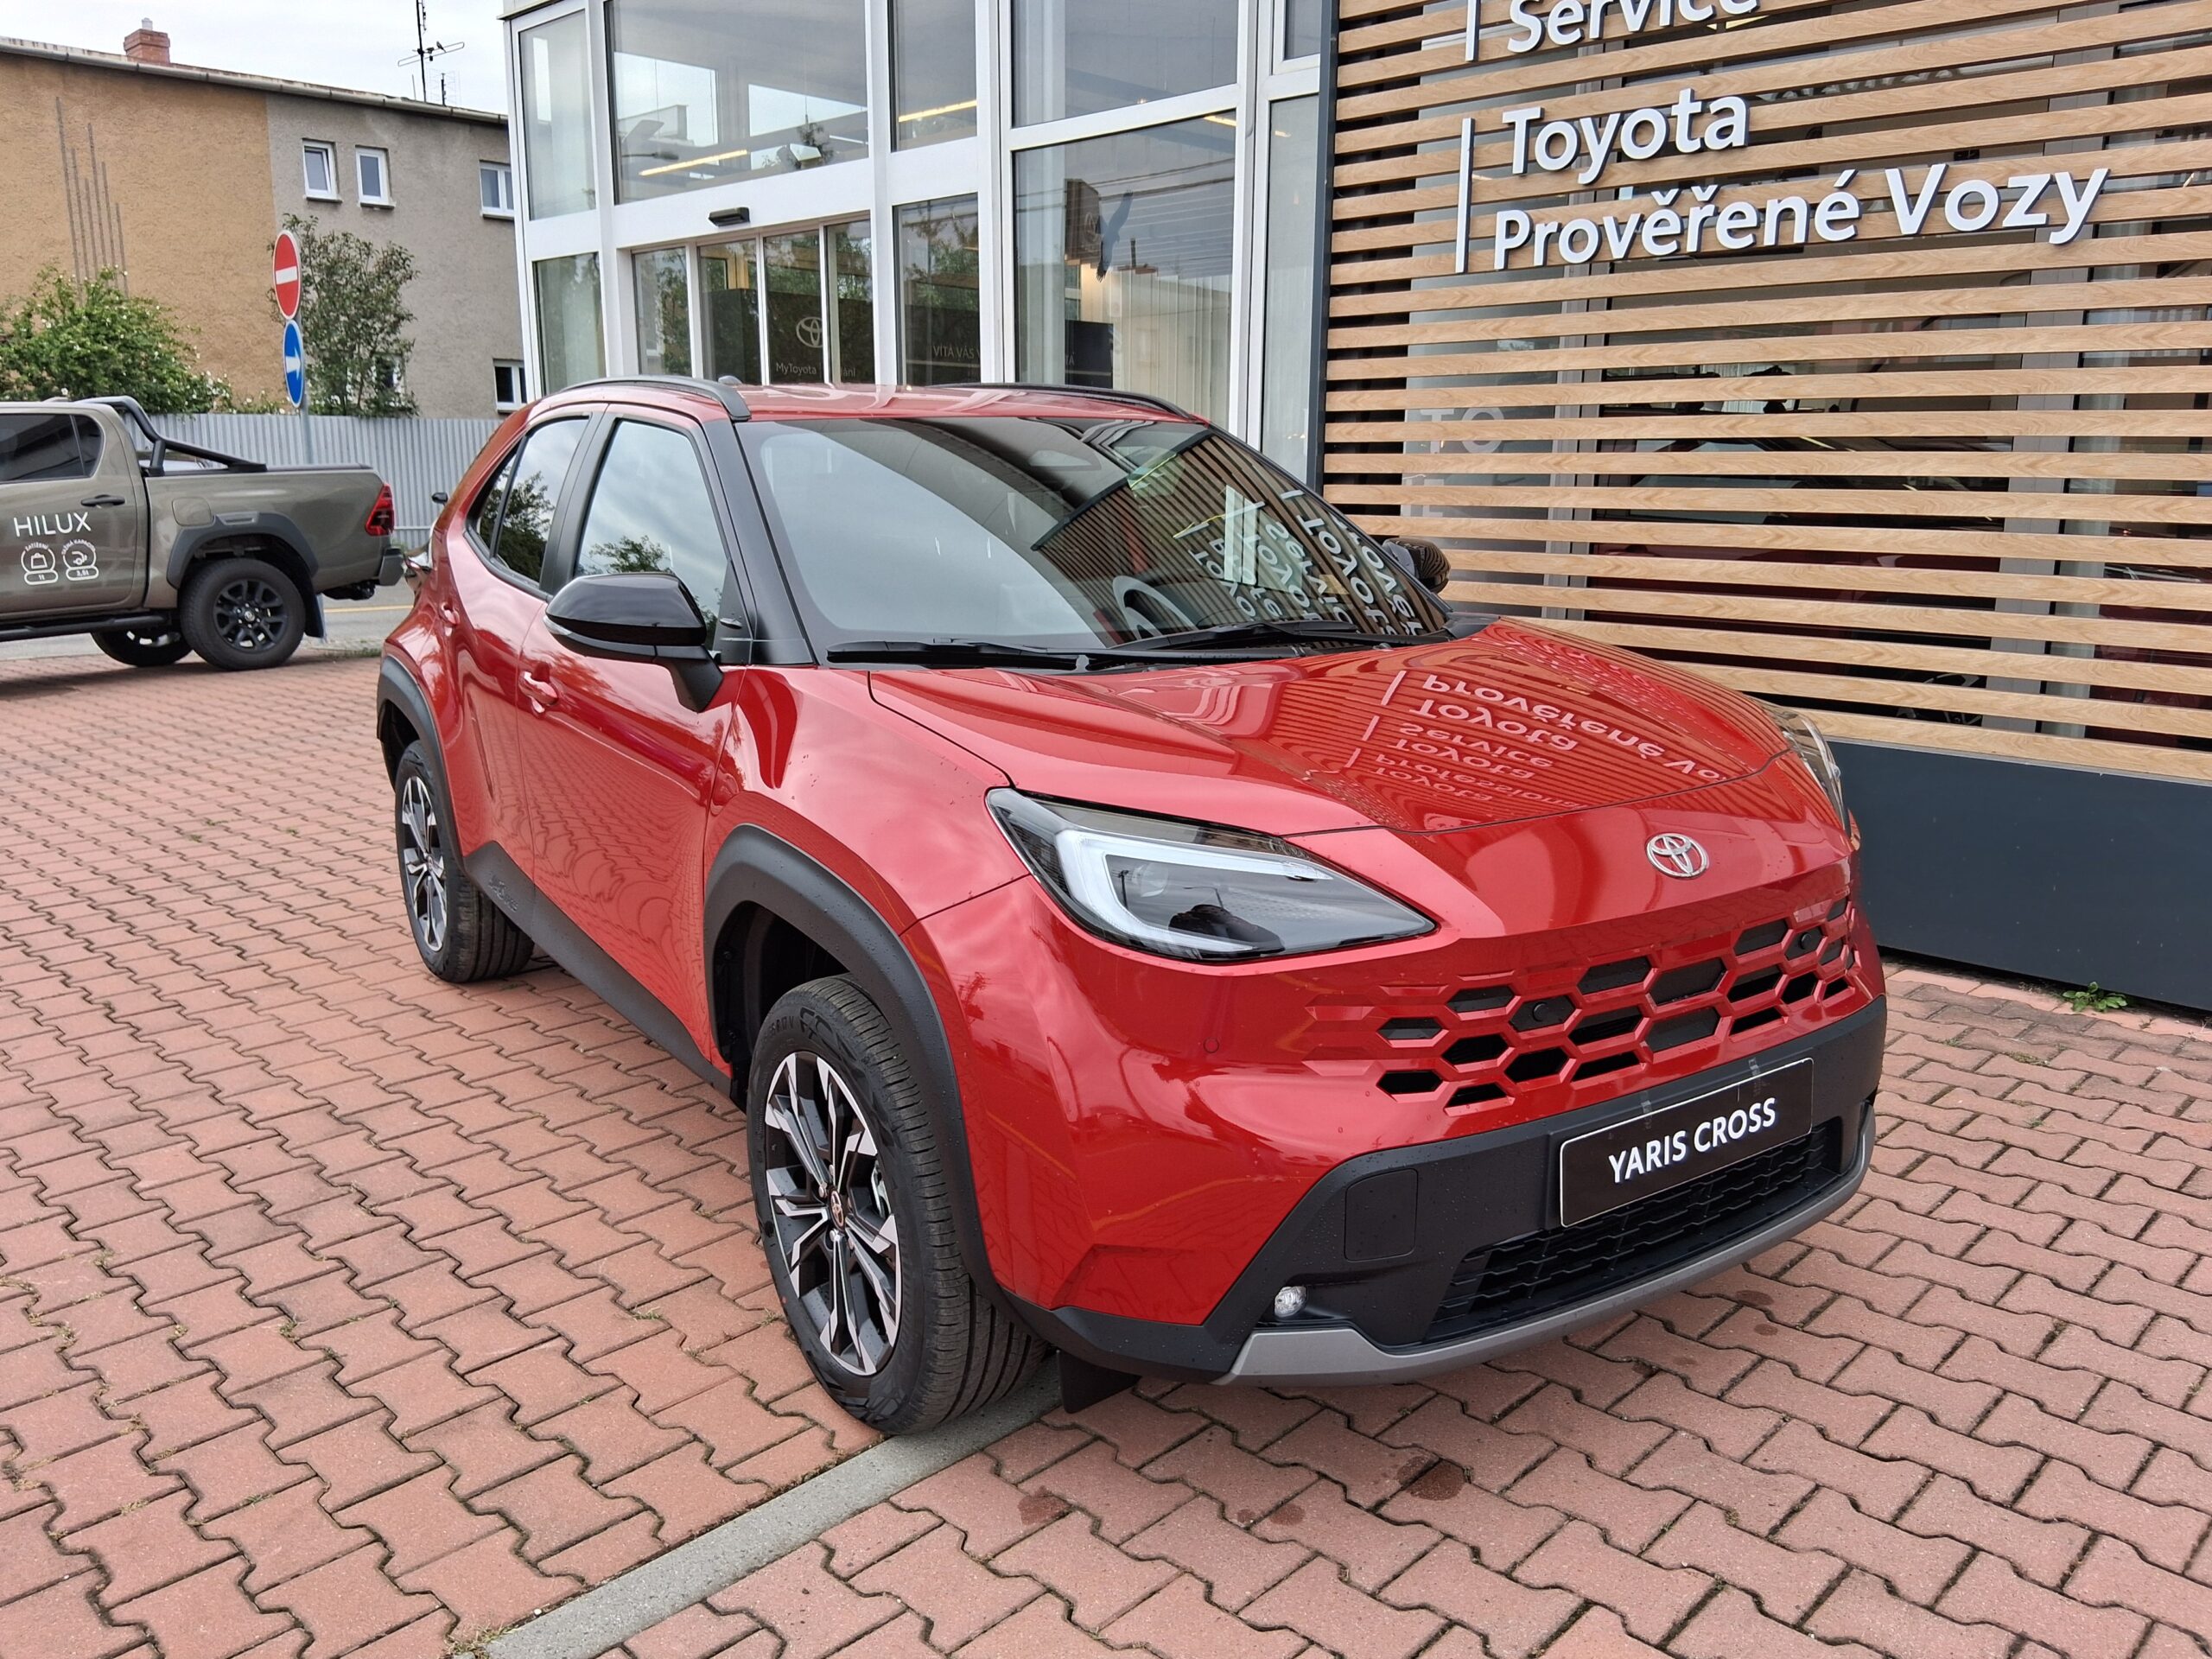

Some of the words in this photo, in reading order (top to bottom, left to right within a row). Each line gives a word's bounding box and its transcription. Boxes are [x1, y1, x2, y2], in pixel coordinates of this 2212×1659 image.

[1501, 86, 1747, 184] Toyota
[1494, 169, 1860, 270] Prověřené
[1885, 162, 2110, 245] Vozy
[775, 362, 817, 375] MyToyota
[14, 512, 92, 537] HILUX
[1608, 1131, 1687, 1183] YARIS
[1694, 1097, 1776, 1152] CROSS
